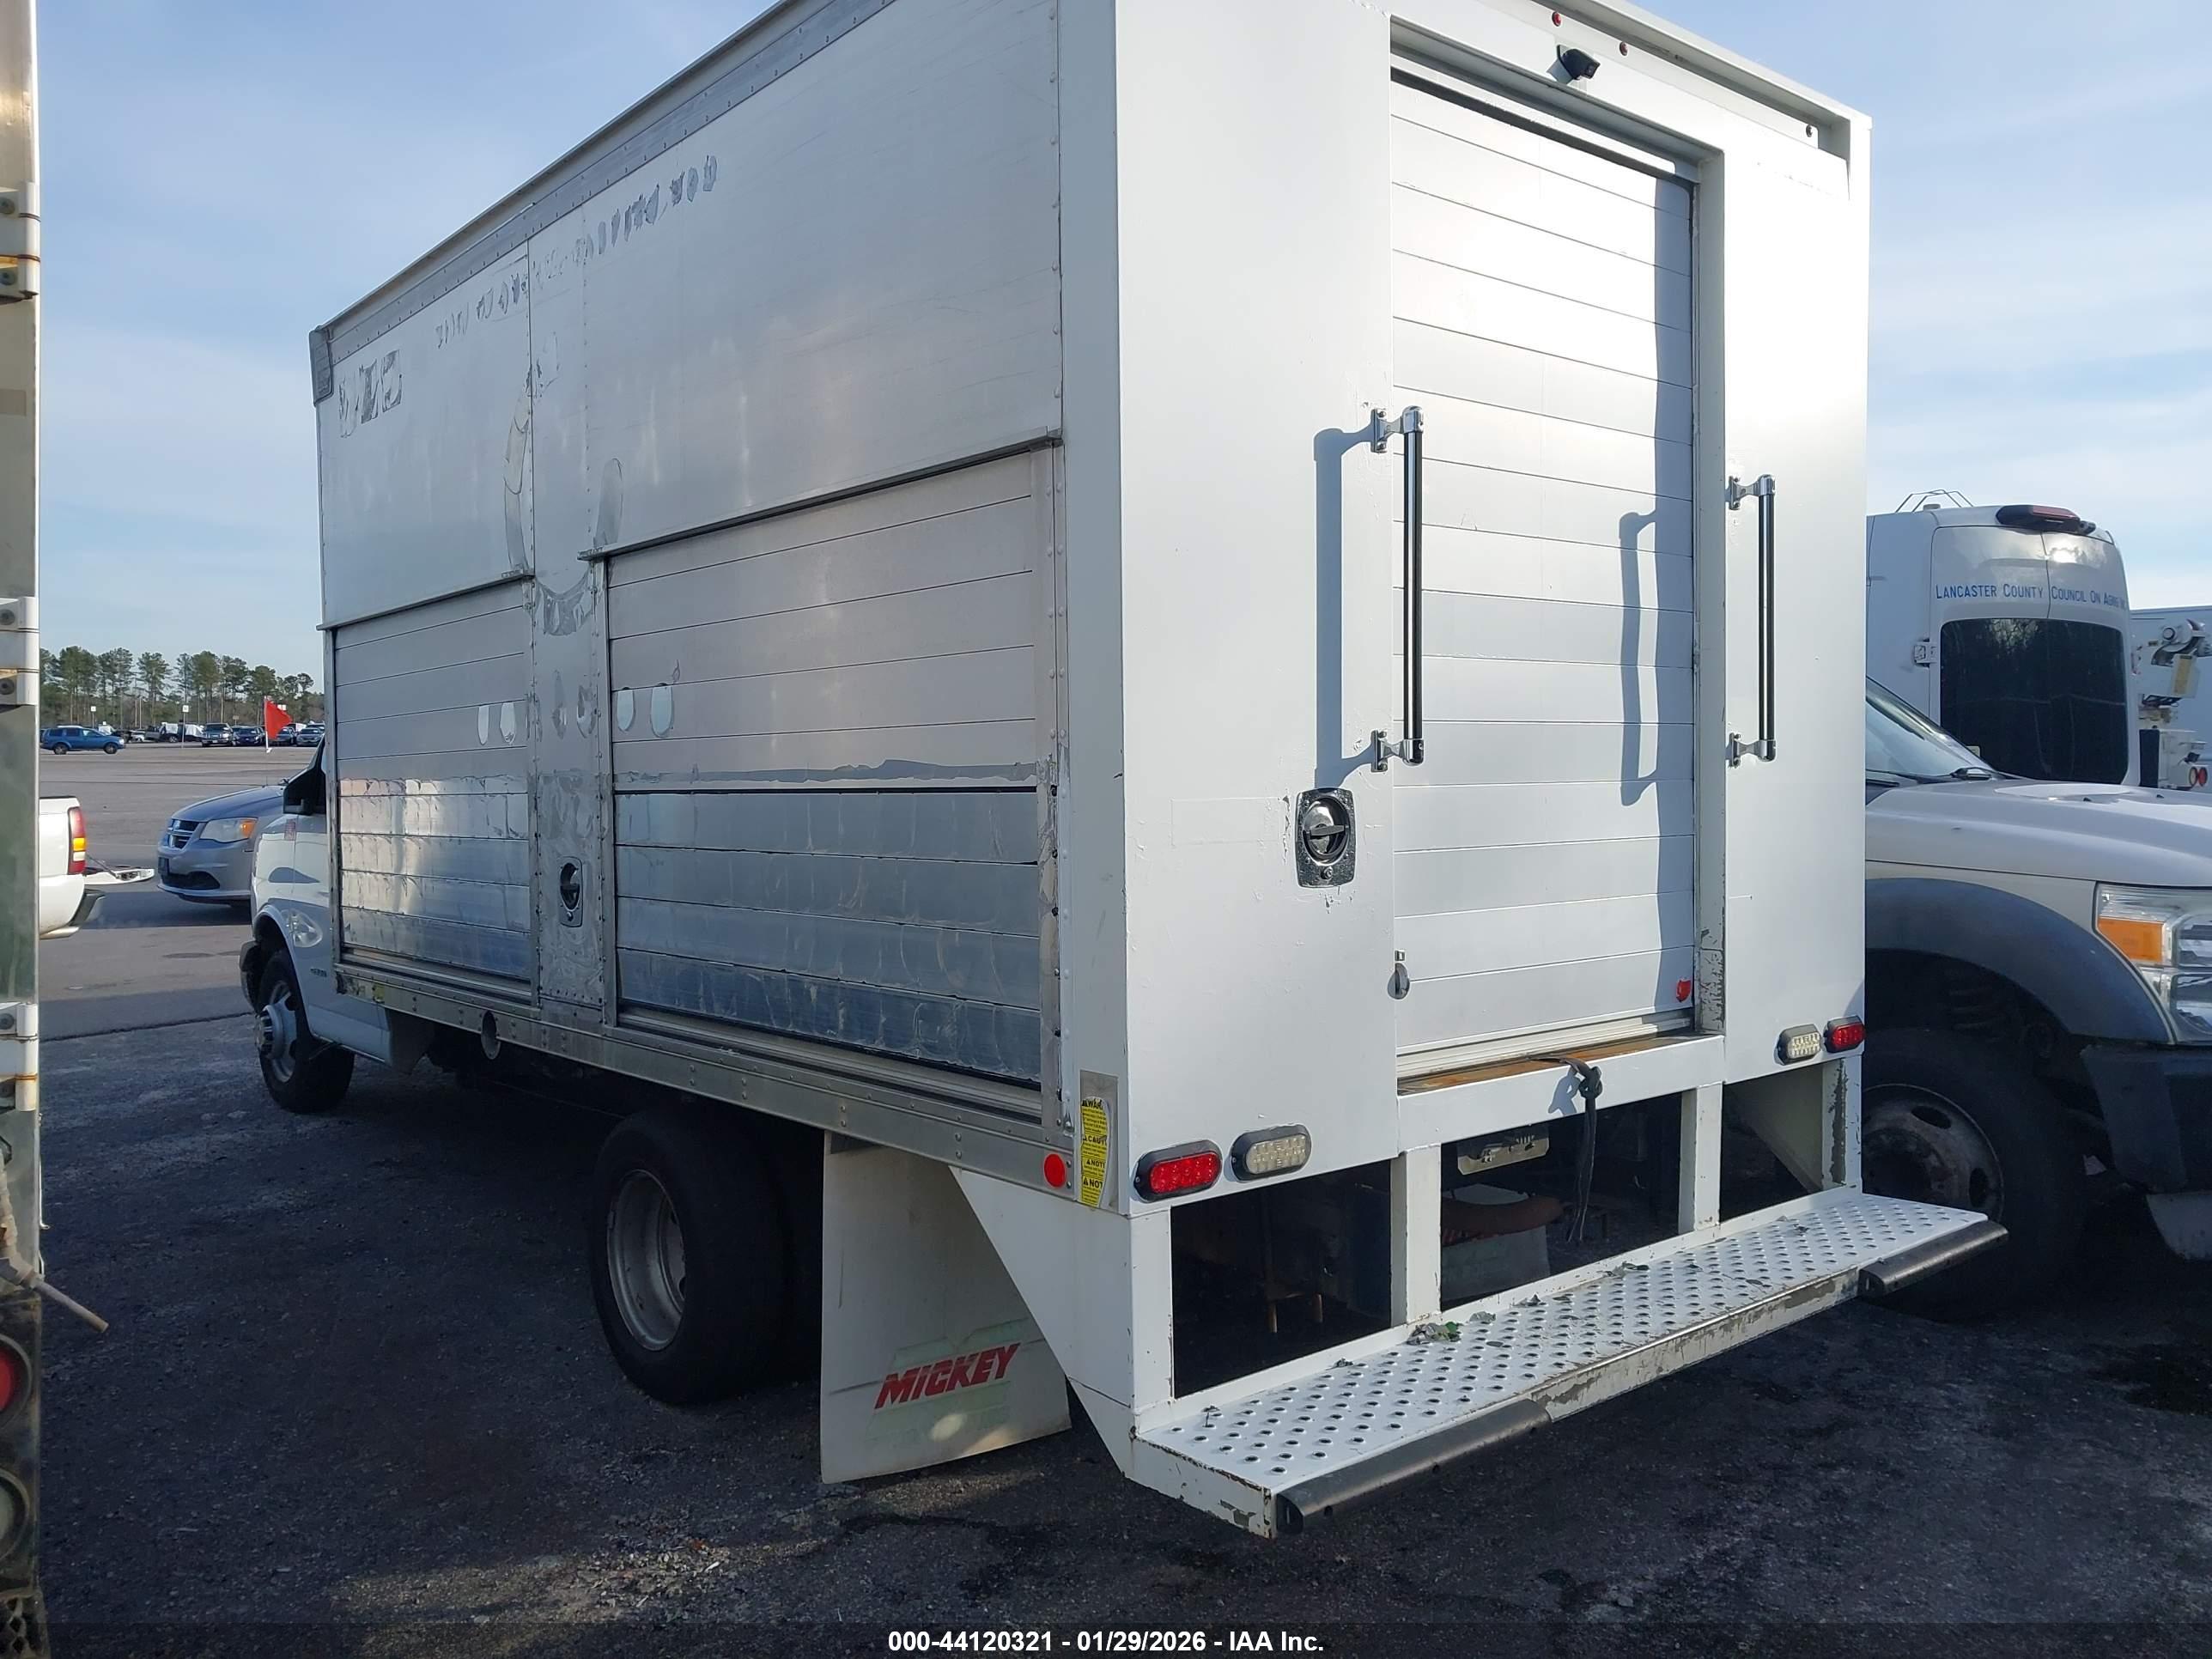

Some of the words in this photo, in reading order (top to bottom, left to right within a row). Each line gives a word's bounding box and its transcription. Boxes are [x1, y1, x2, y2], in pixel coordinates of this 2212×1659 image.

[1936, 583, 1997, 599] LANCASTER
[2002, 583, 2044, 599] COUNTY
[2051, 585, 2087, 603] COUNCIL
[874, 1342, 1021, 1410] MICKEY
